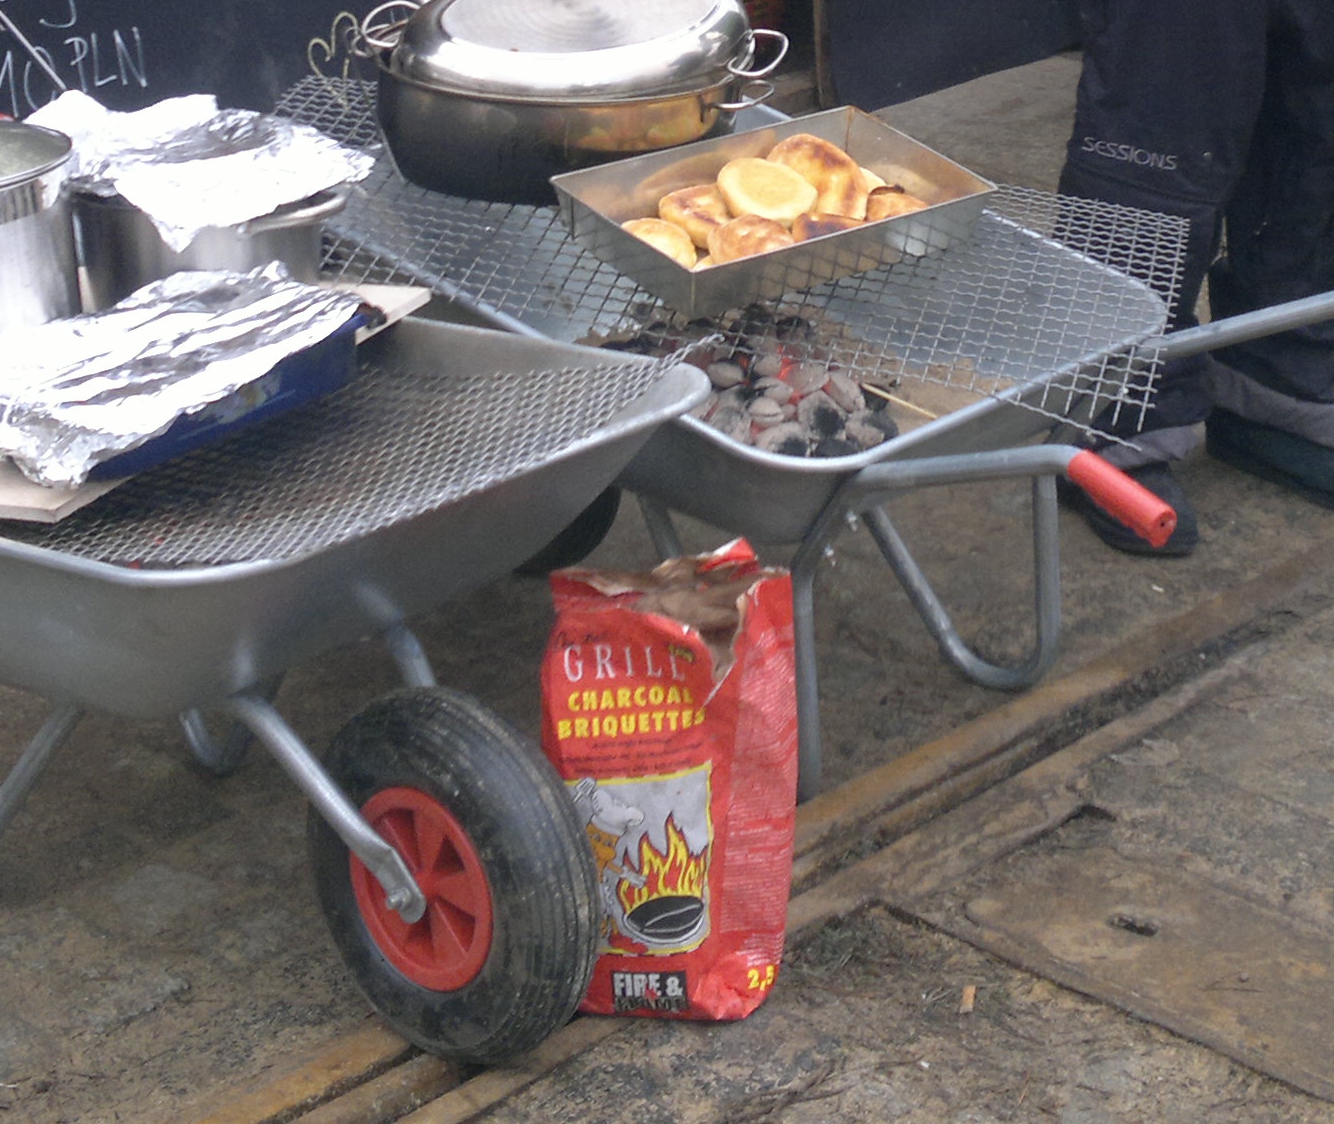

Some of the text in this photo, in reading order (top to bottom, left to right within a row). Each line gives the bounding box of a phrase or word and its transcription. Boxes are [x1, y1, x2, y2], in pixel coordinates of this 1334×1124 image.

[63, 27, 148, 94] PLN
[1081, 135, 1178, 170] SESSIONS
[563, 643, 685, 683] GRILL
[568, 684, 694, 712] CHARCOAL
[557, 707, 706, 740] BRIQUETTES
[612, 972, 683, 997] FIRE &
